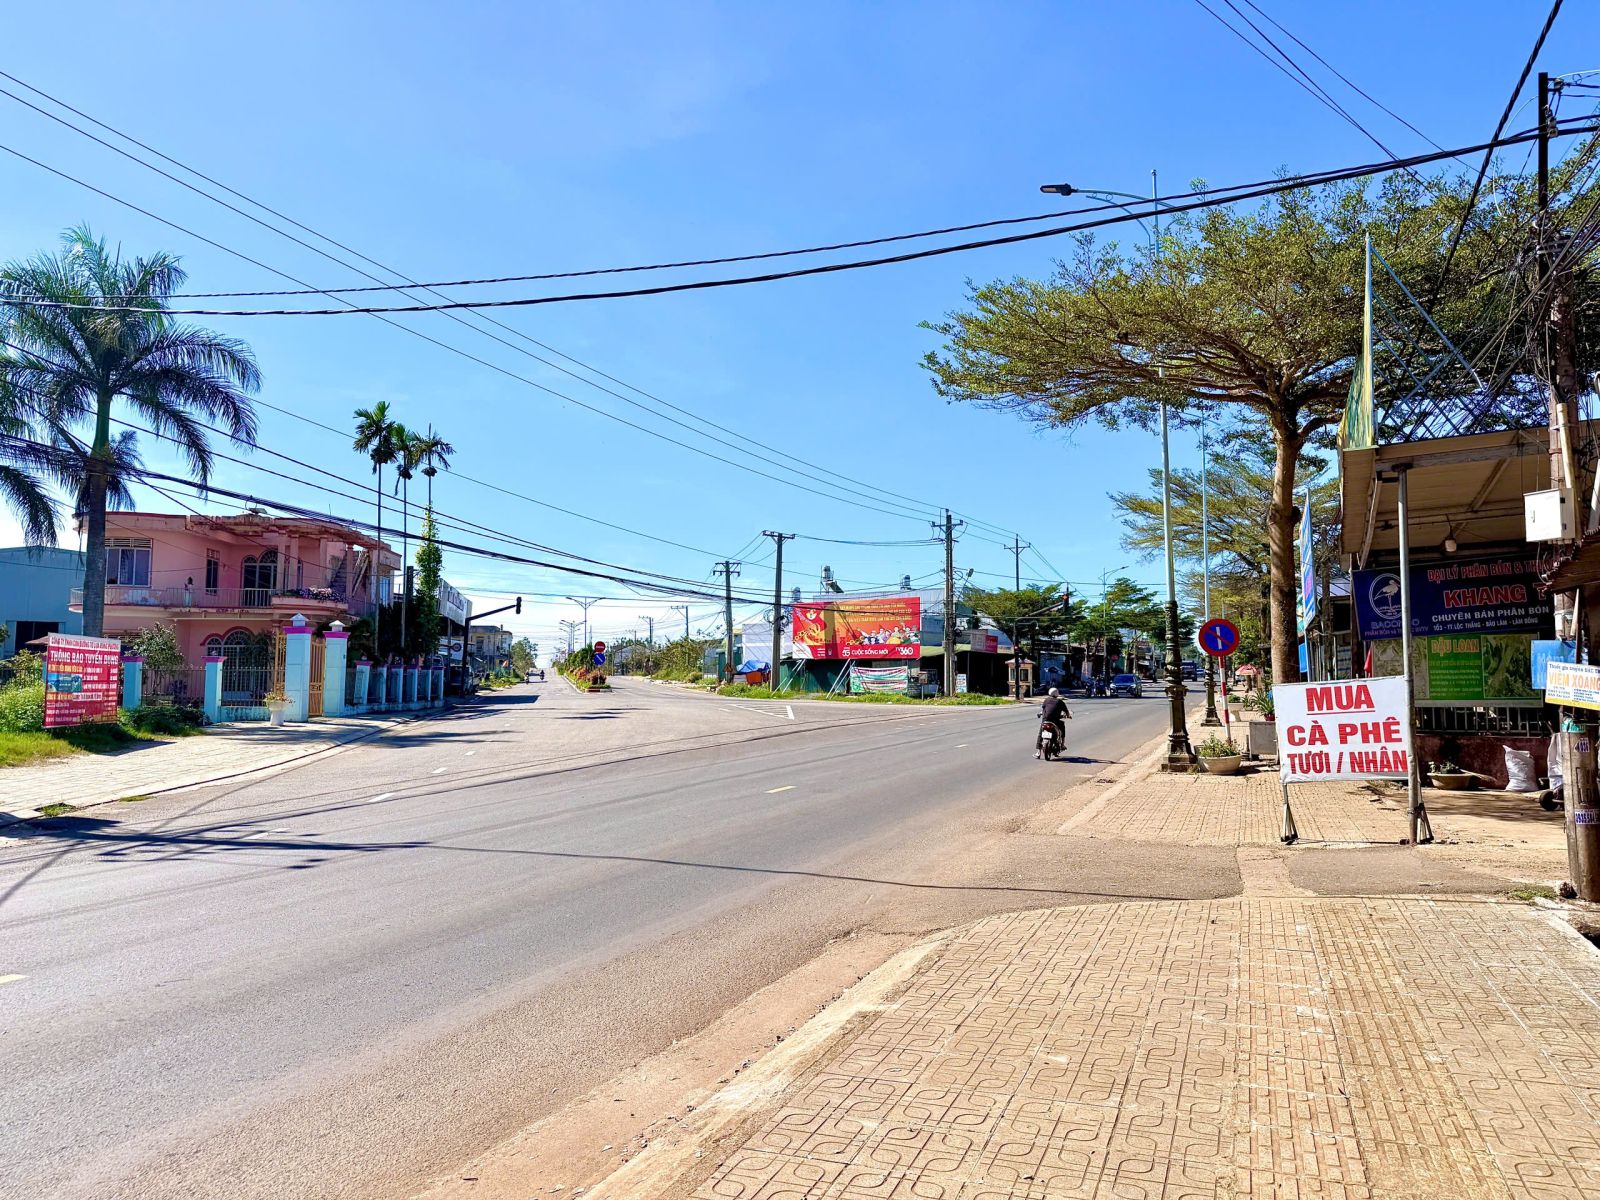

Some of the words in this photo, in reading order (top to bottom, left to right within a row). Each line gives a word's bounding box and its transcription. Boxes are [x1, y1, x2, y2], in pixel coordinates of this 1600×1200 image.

[1447, 564, 1459, 580] LÝ
[1461, 563, 1489, 578] PHÂN
[1514, 561, 1523, 574] &
[1443, 584, 1527, 609] KHANG
[1431, 611, 1471, 623] CHUYÊN
[1474, 609, 1495, 620] BÁN
[1497, 607, 1525, 618] PHÂN
[50, 649, 71, 662] THÔNG
[72, 650, 83, 664] BÁO
[1572, 672, 1600, 691] XOANG
[1305, 684, 1375, 712] MUA
[1286, 719, 1329, 747] CÀ
[1338, 716, 1403, 745] PHÊ
[1286, 750, 1331, 775] TƯƠI
[1336, 751, 1344, 774] /
[1349, 746, 1409, 774] NHÂN
